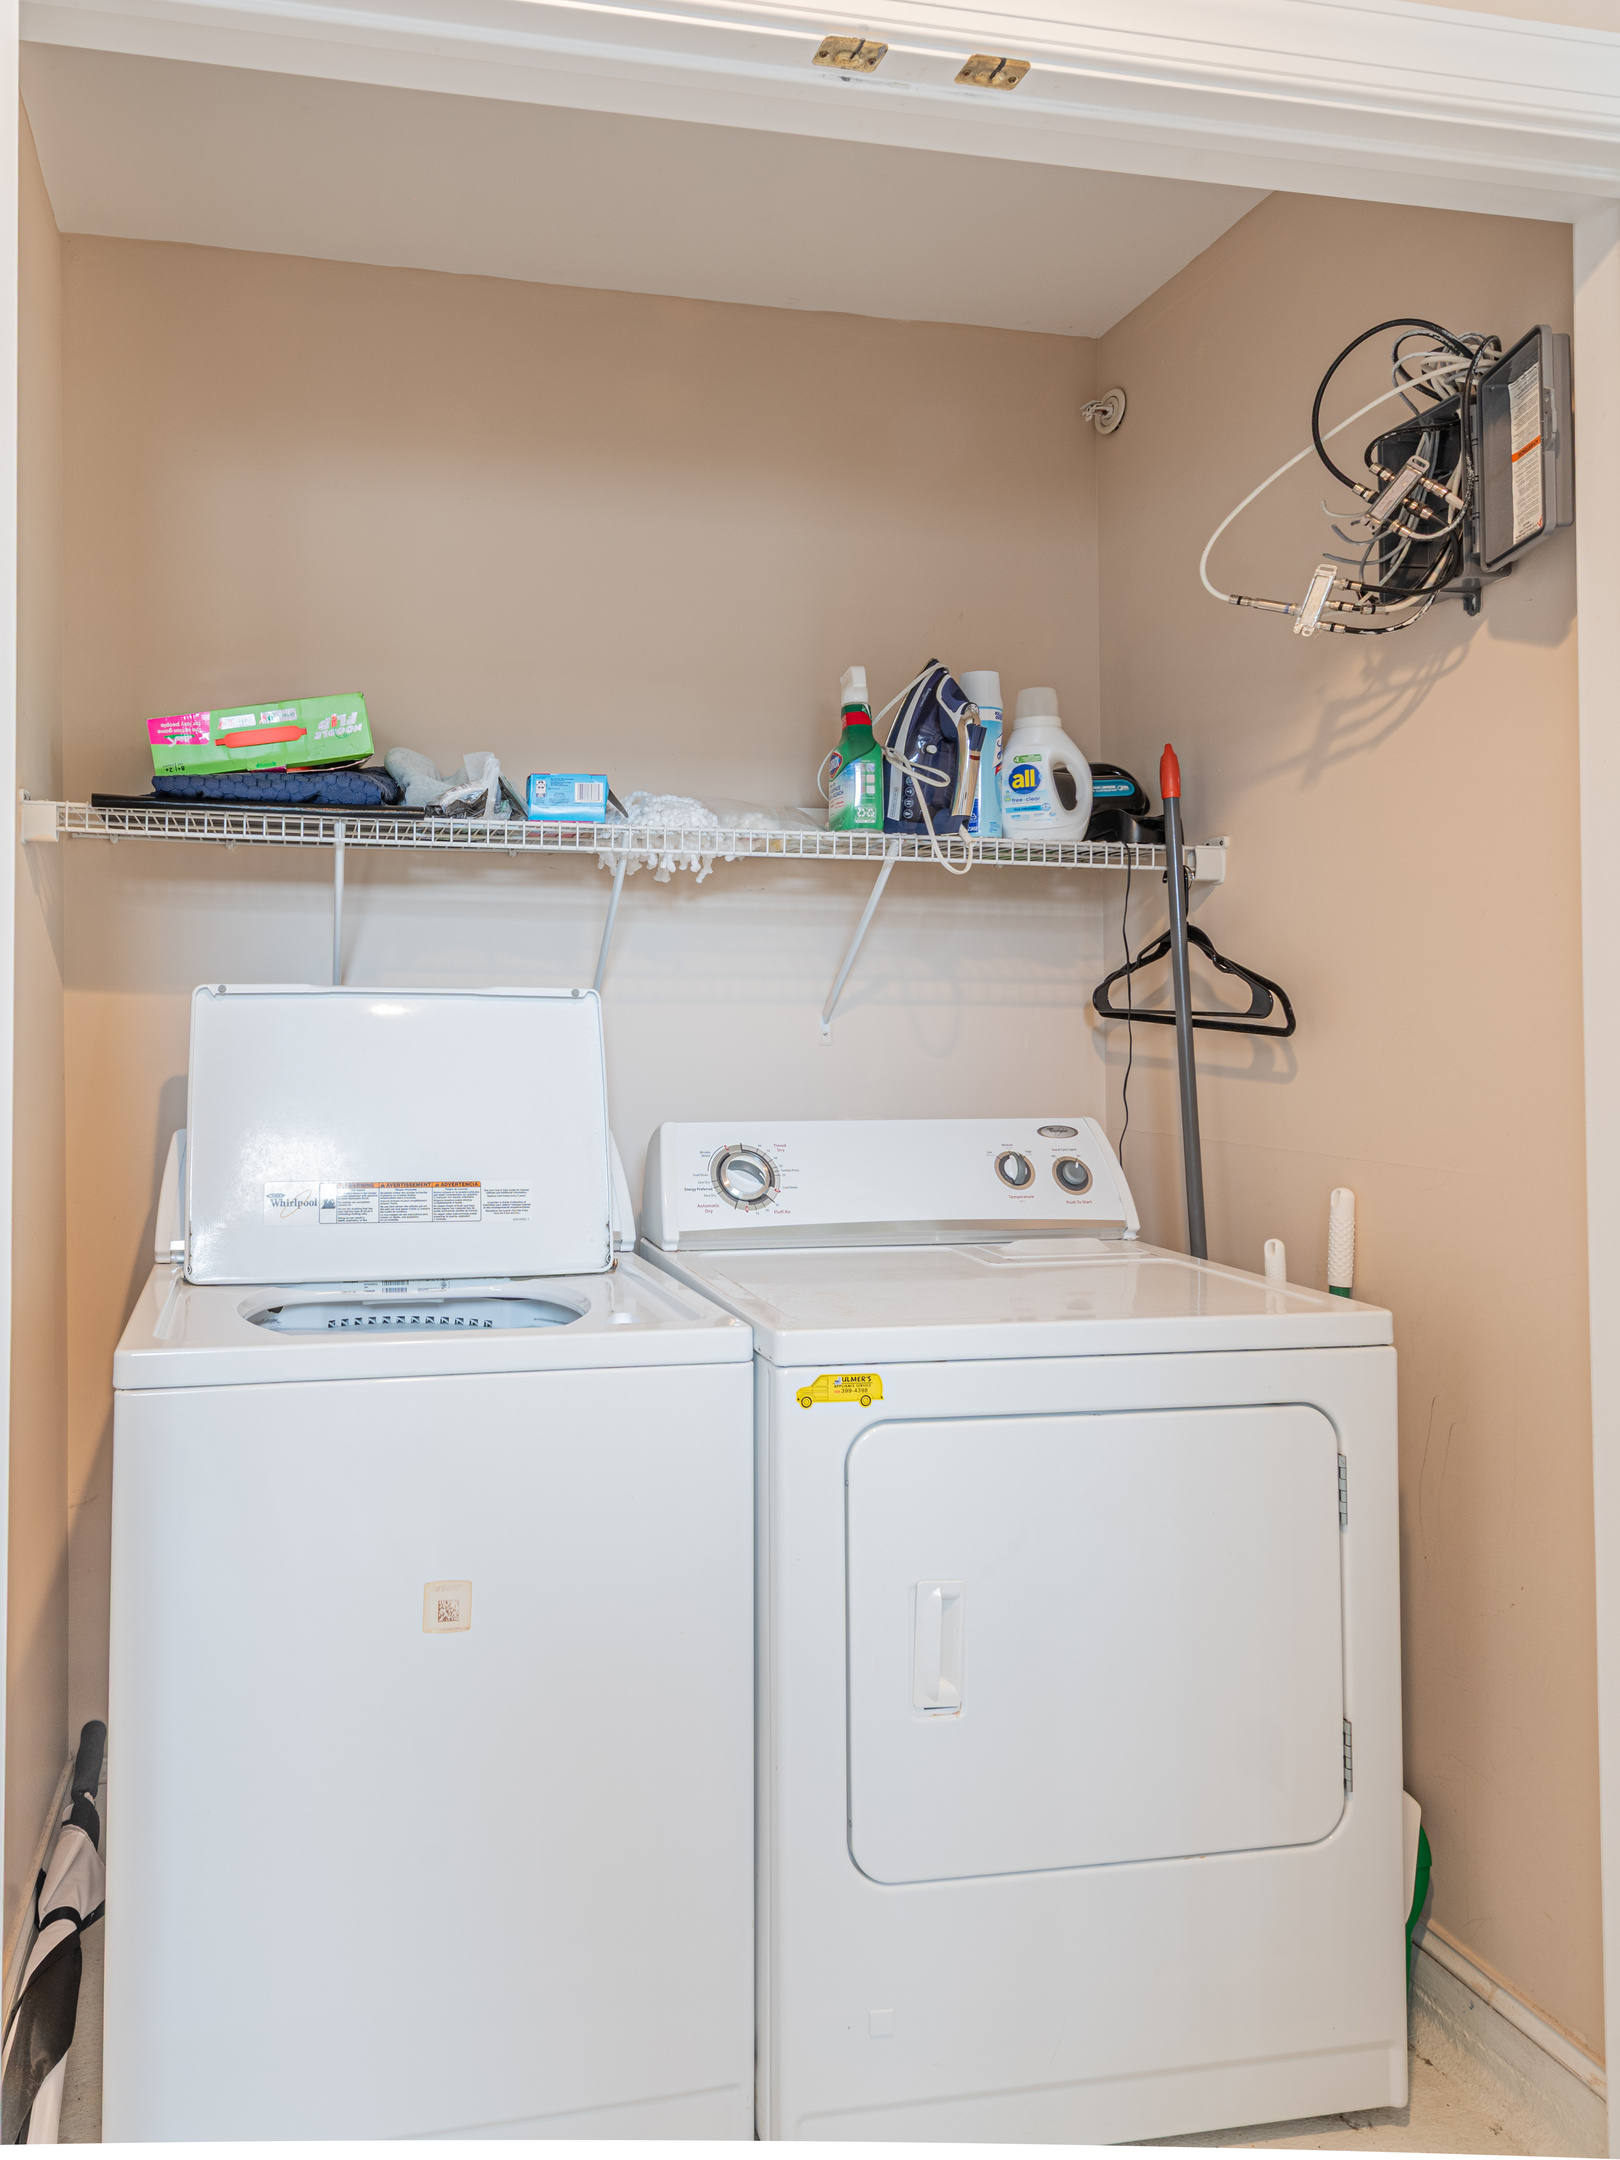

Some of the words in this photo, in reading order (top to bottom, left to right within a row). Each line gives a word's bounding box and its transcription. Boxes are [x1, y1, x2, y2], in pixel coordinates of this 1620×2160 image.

[318, 711, 358, 730] FLIP
[314, 723, 362, 740] NOODLE
[1012, 769, 1036, 789] all
[270, 1197, 318, 1209] Whirlpool
[841, 1375, 872, 1383] ULMER'S
